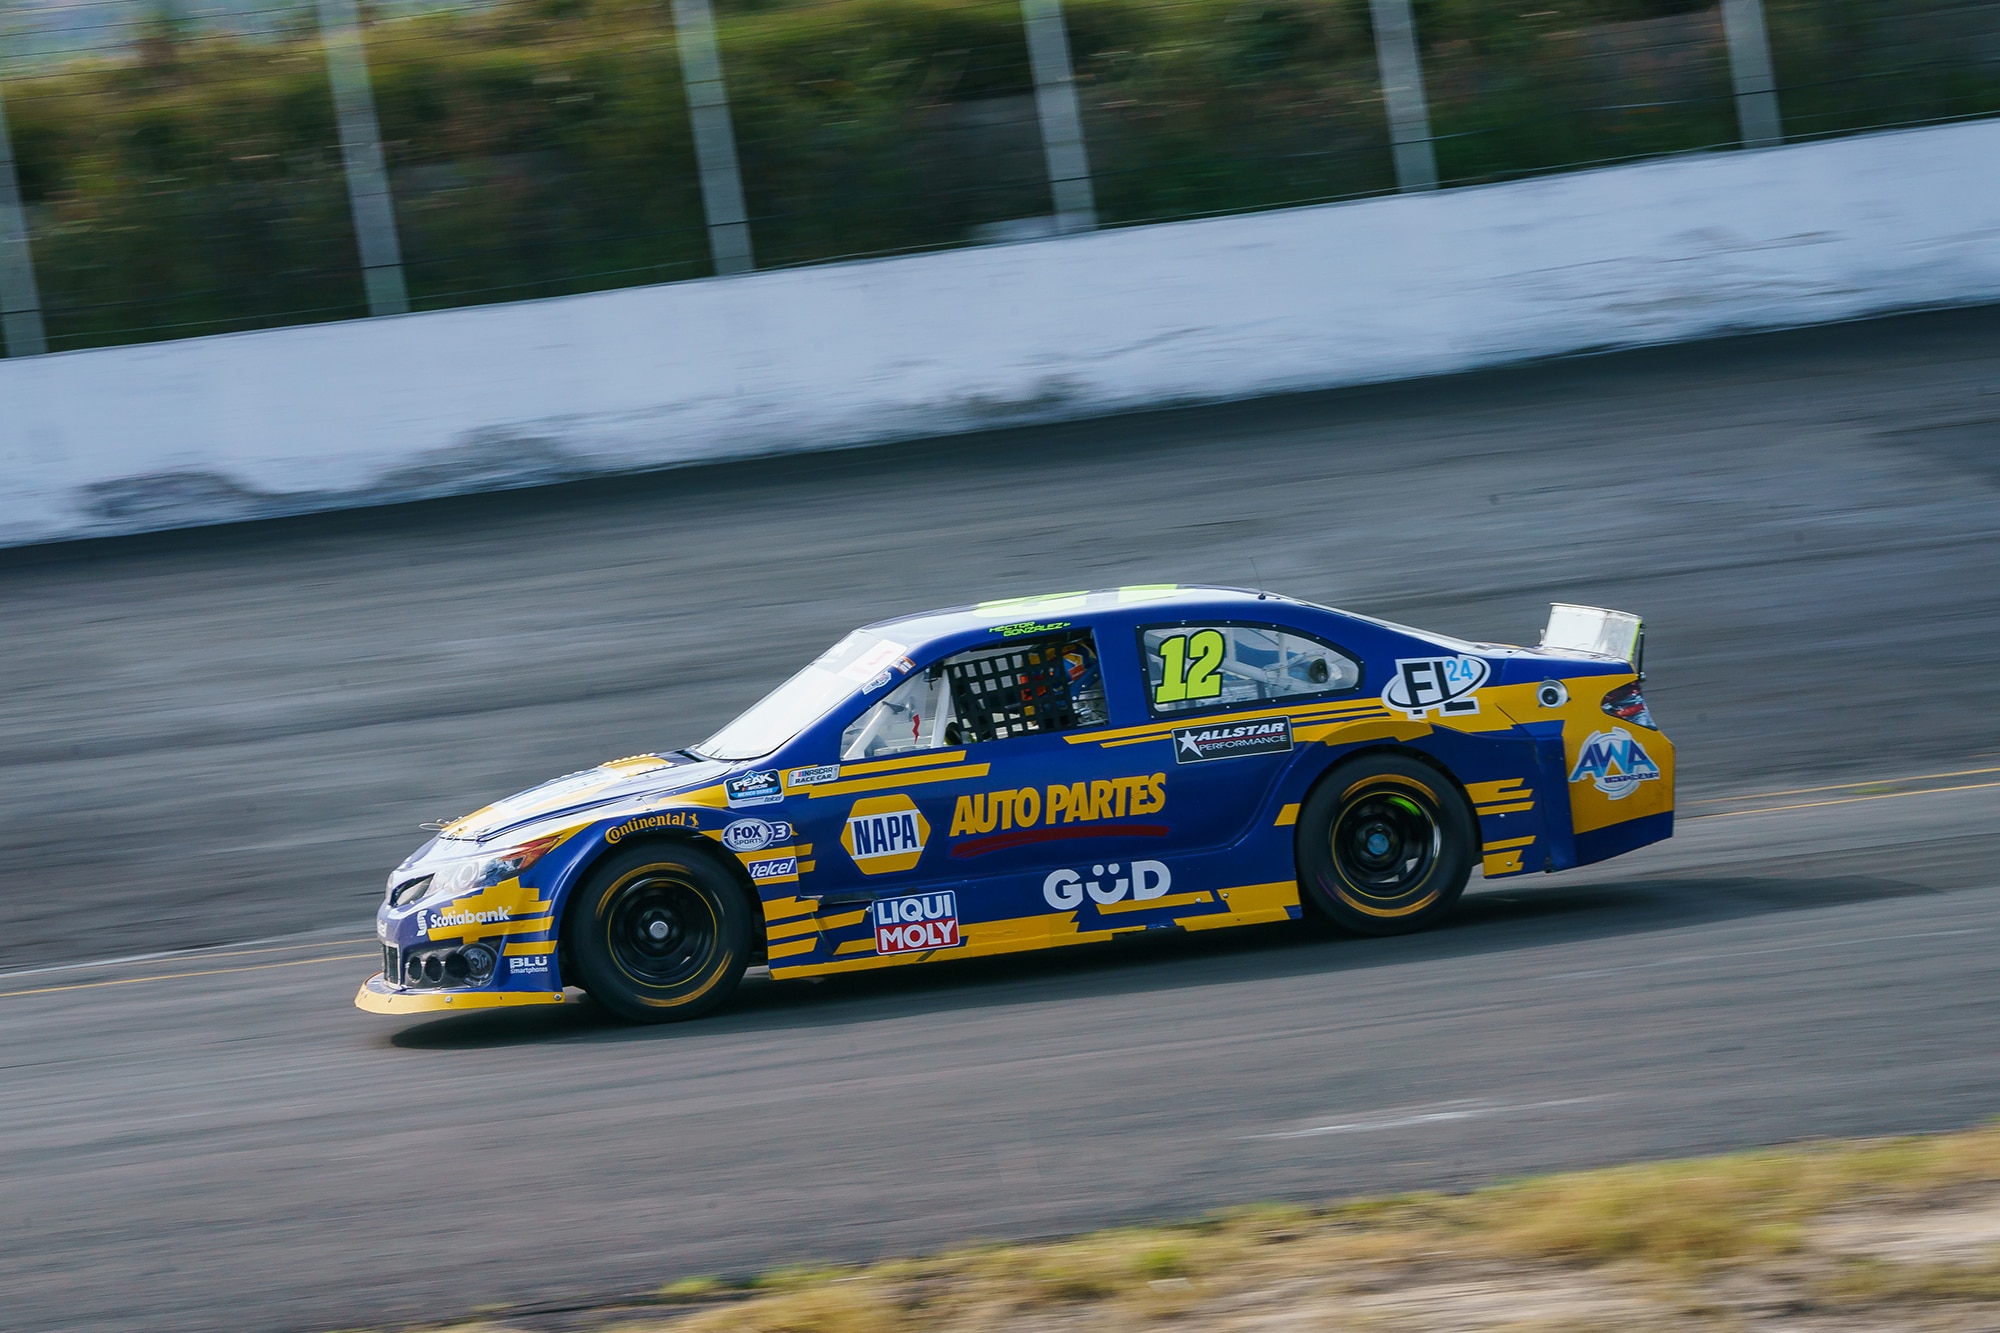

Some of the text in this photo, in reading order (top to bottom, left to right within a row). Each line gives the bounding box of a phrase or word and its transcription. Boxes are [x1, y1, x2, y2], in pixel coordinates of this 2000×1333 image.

[989, 621, 1035, 632] HECTOR
[1155, 628, 1225, 704] 12
[1446, 660, 1473, 682] 24
[1402, 661, 1475, 715] FL
[1197, 722, 1285, 742] ALLSTAR
[1199, 735, 1287, 751] PERFORMANCE
[1569, 740, 1660, 782] AWA
[733, 773, 774, 789] PEAK
[795, 776, 815, 784] RACE
[805, 767, 832, 777] NASCAR
[949, 773, 1167, 837] AUTO PARTES
[605, 812, 686, 844] Continental
[733, 826, 762, 840] FOX
[775, 825, 786, 838] 3
[853, 814, 919, 856] NAPA
[751, 858, 795, 878] telcel
[430, 908, 510, 928] Scotiabank
[877, 894, 953, 925] LIQUI
[880, 919, 957, 952] MOLY
[509, 967, 549, 975] smartphones
